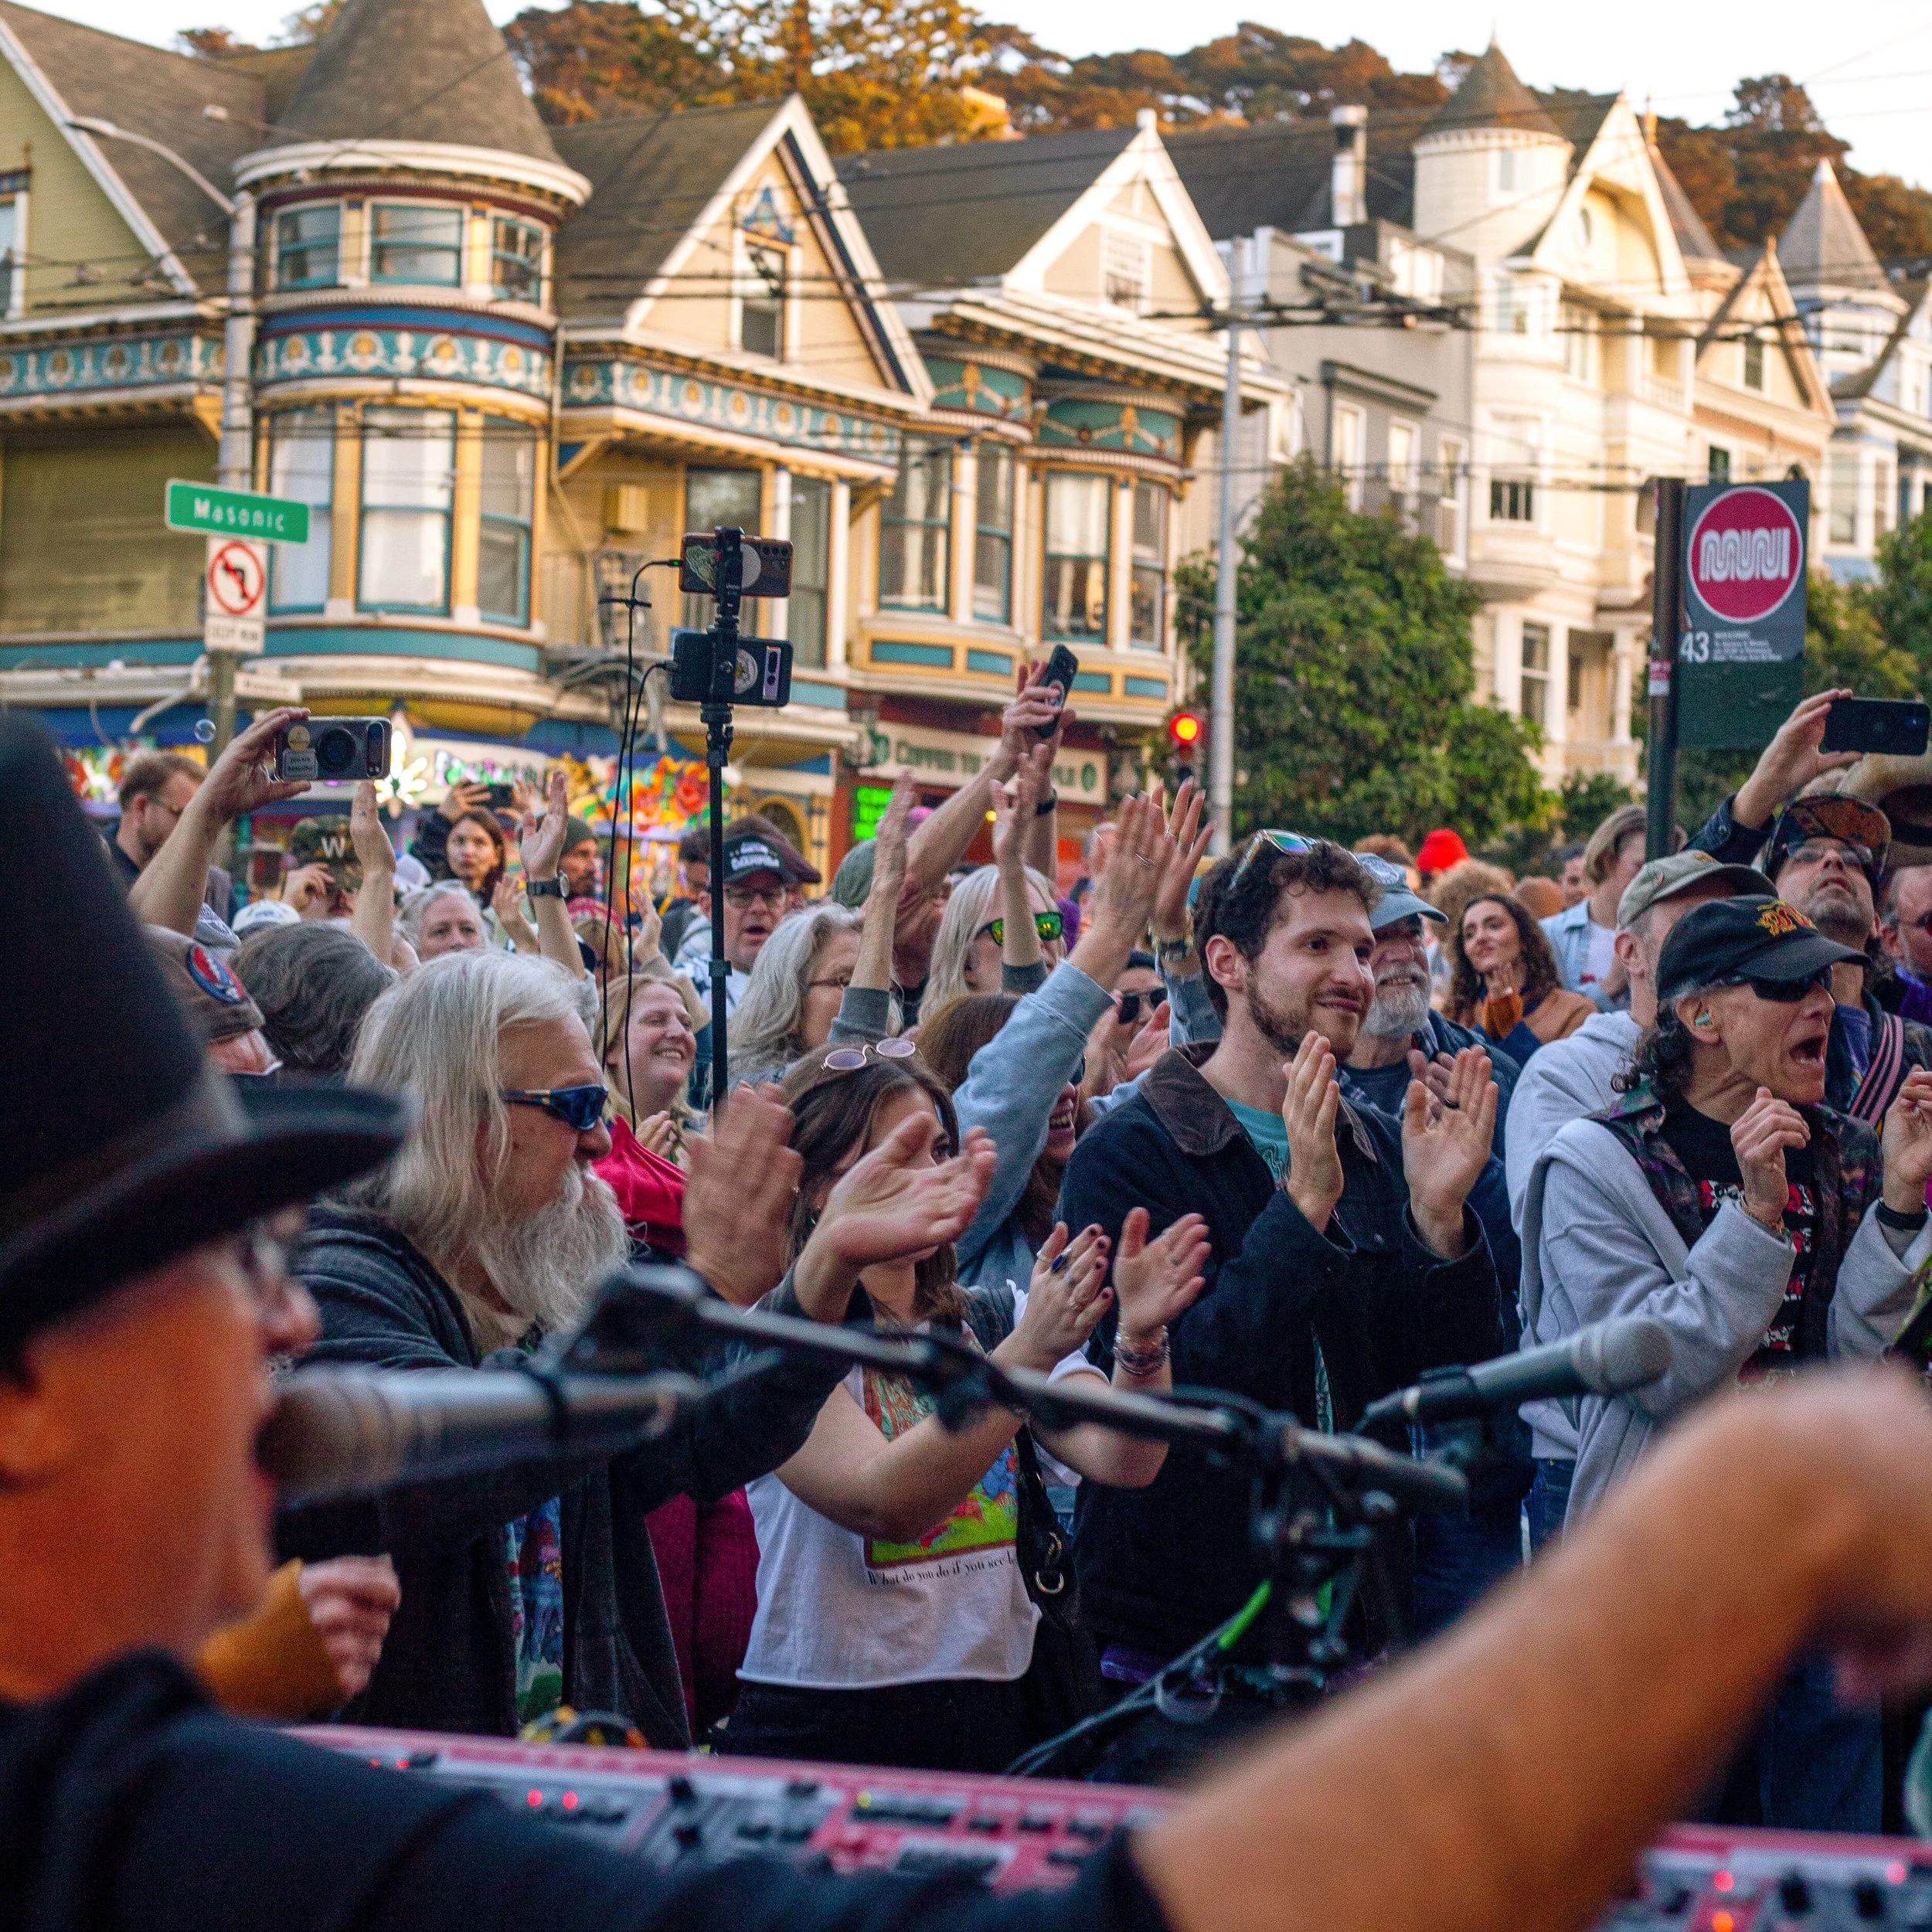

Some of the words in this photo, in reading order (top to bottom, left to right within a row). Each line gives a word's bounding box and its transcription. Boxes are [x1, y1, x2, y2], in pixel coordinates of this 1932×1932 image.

[194, 497, 284, 532] Masonic
[1679, 631, 1709, 663] 43
[321, 835, 346, 858] W
[867, 1570, 900, 1586] What
[902, 1568, 916, 1582] do
[917, 1570, 934, 1583] you
[936, 1563, 951, 1578] do
[951, 1560, 962, 1574] if
[964, 1561, 985, 1577] you
[988, 1556, 1004, 1569] see
